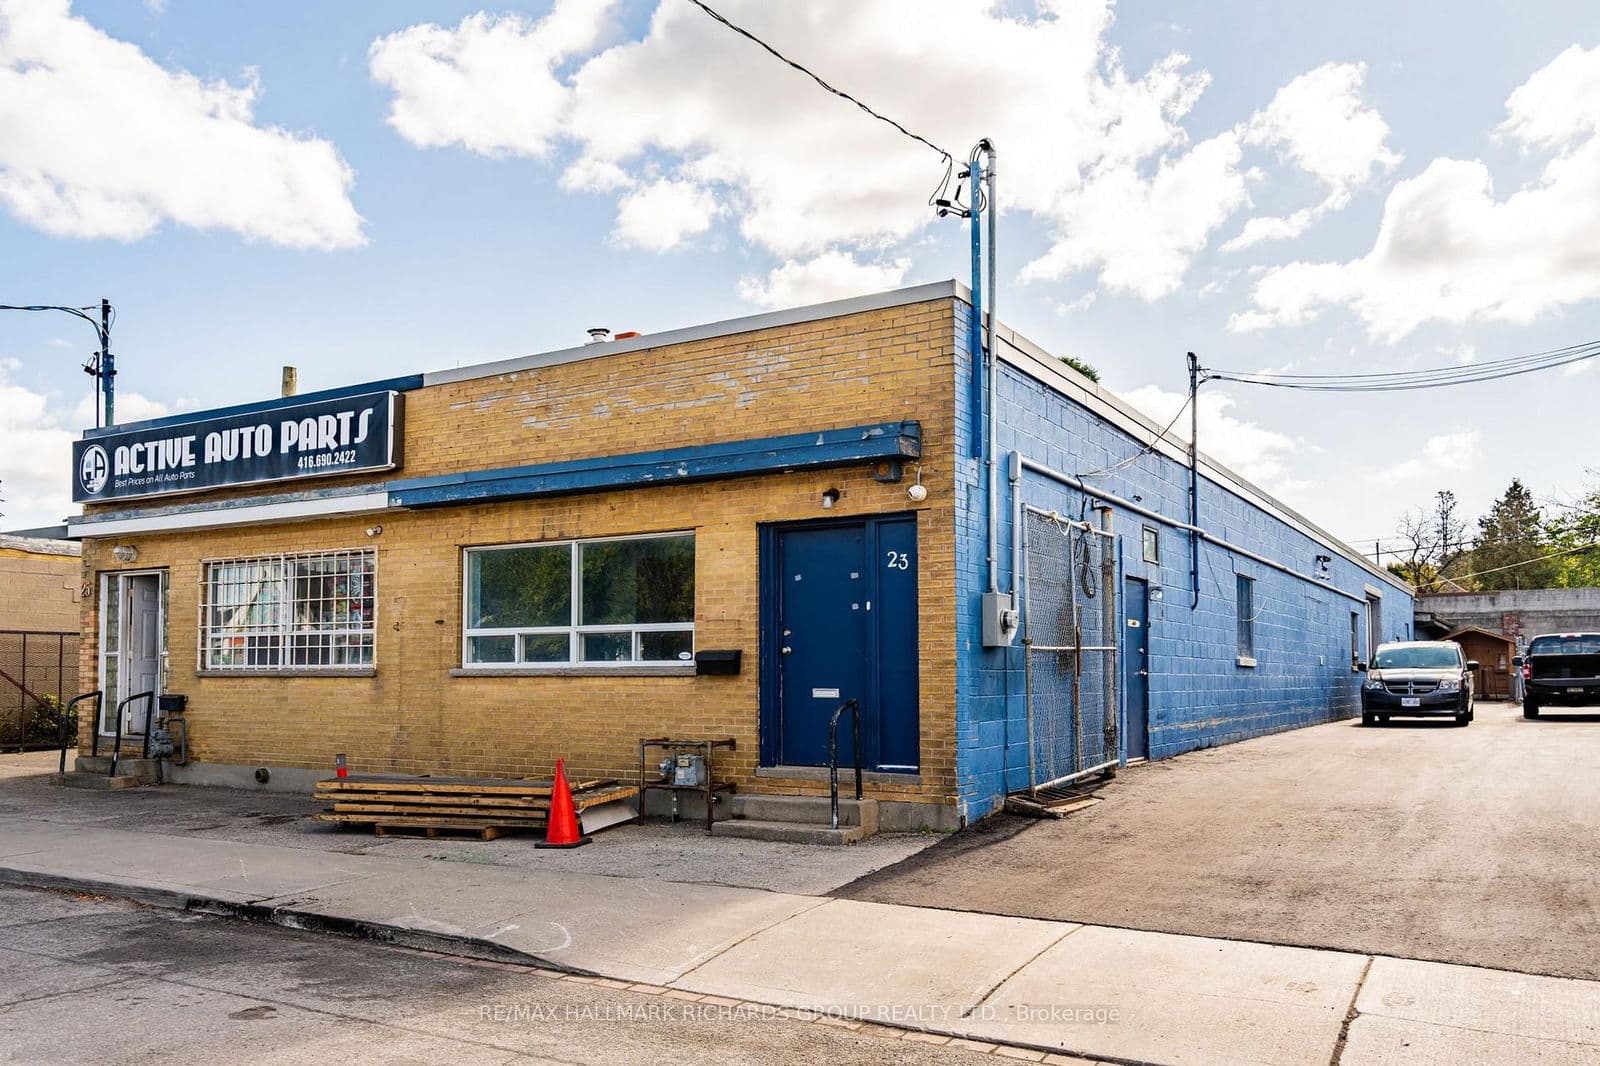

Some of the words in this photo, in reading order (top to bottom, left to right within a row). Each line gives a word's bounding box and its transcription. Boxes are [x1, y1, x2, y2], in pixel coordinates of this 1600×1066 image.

[114, 436, 196, 476] ACTIVE
[204, 423, 273, 465] AUTO
[280, 408, 374, 454] PARTS
[297, 449, 356, 469] 416.690.2422
[114, 479, 127, 488] Best
[128, 477, 146, 486] Prices
[154, 473, 164, 483] All
[164, 473, 179, 482] Auto
[179, 471, 196, 480] Parts
[887, 551, 909, 570] 23
[80, 581, 92, 598] 25
